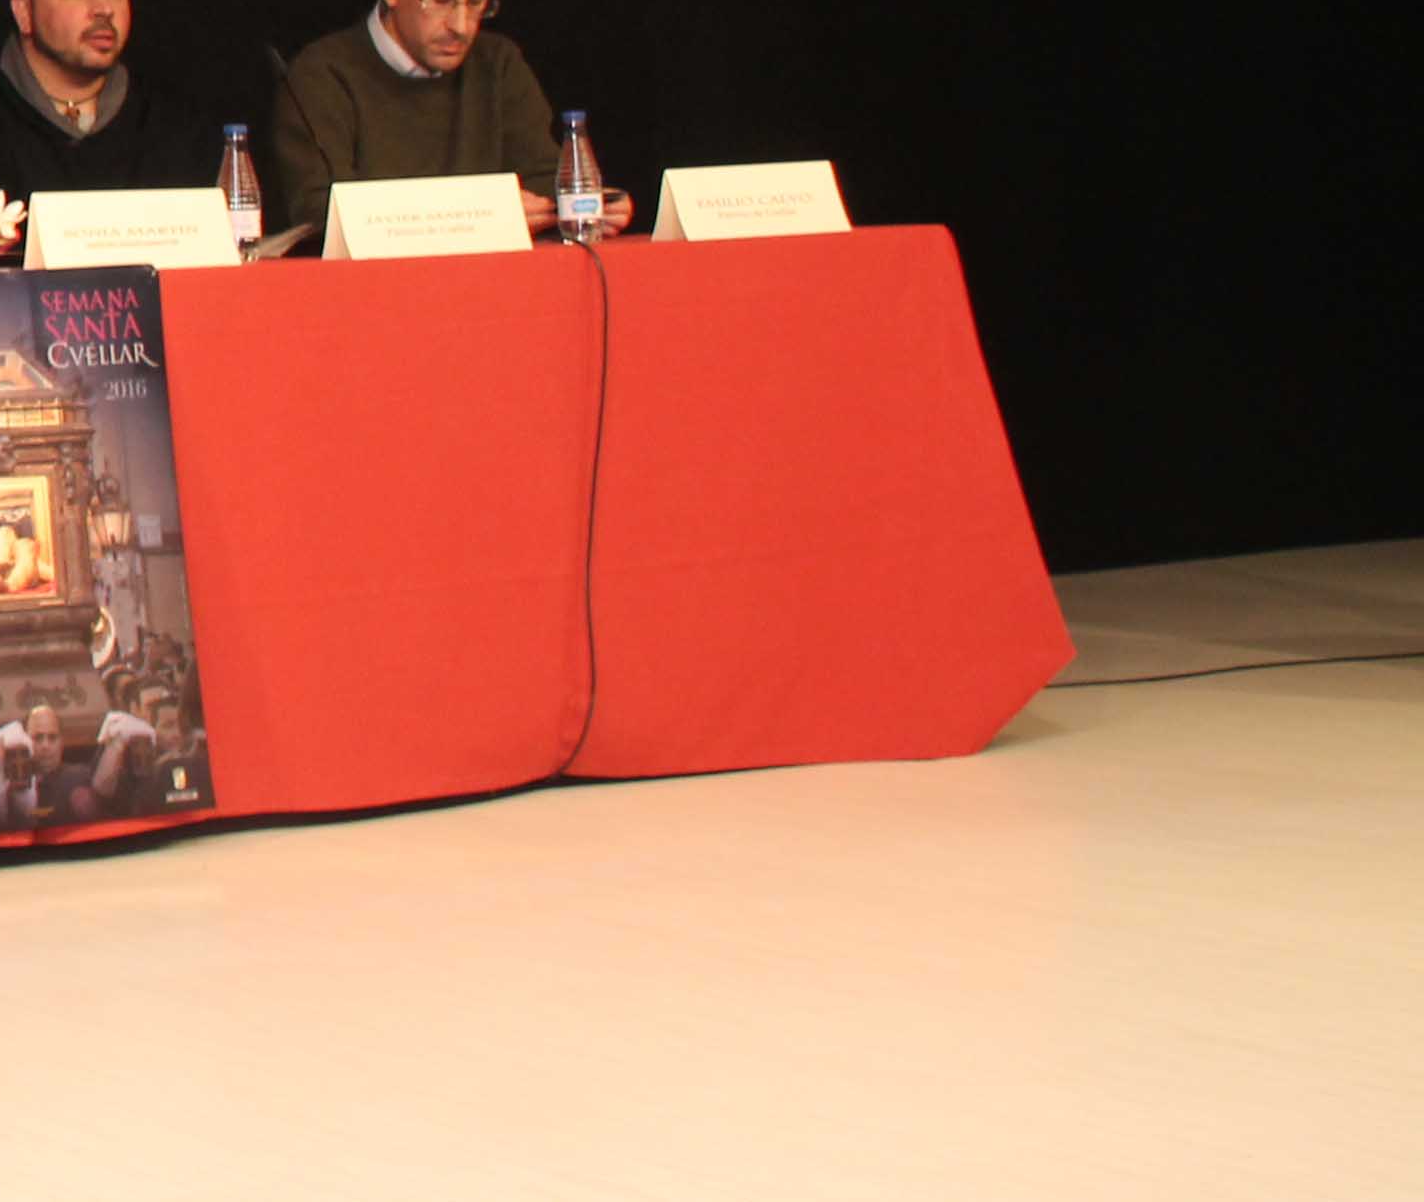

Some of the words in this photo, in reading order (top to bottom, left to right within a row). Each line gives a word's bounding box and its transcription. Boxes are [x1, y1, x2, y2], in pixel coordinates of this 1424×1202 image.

[40, 286, 142, 314] SEMANA
[44, 307, 144, 343] SANTA
[104, 376, 148, 401] 2016
